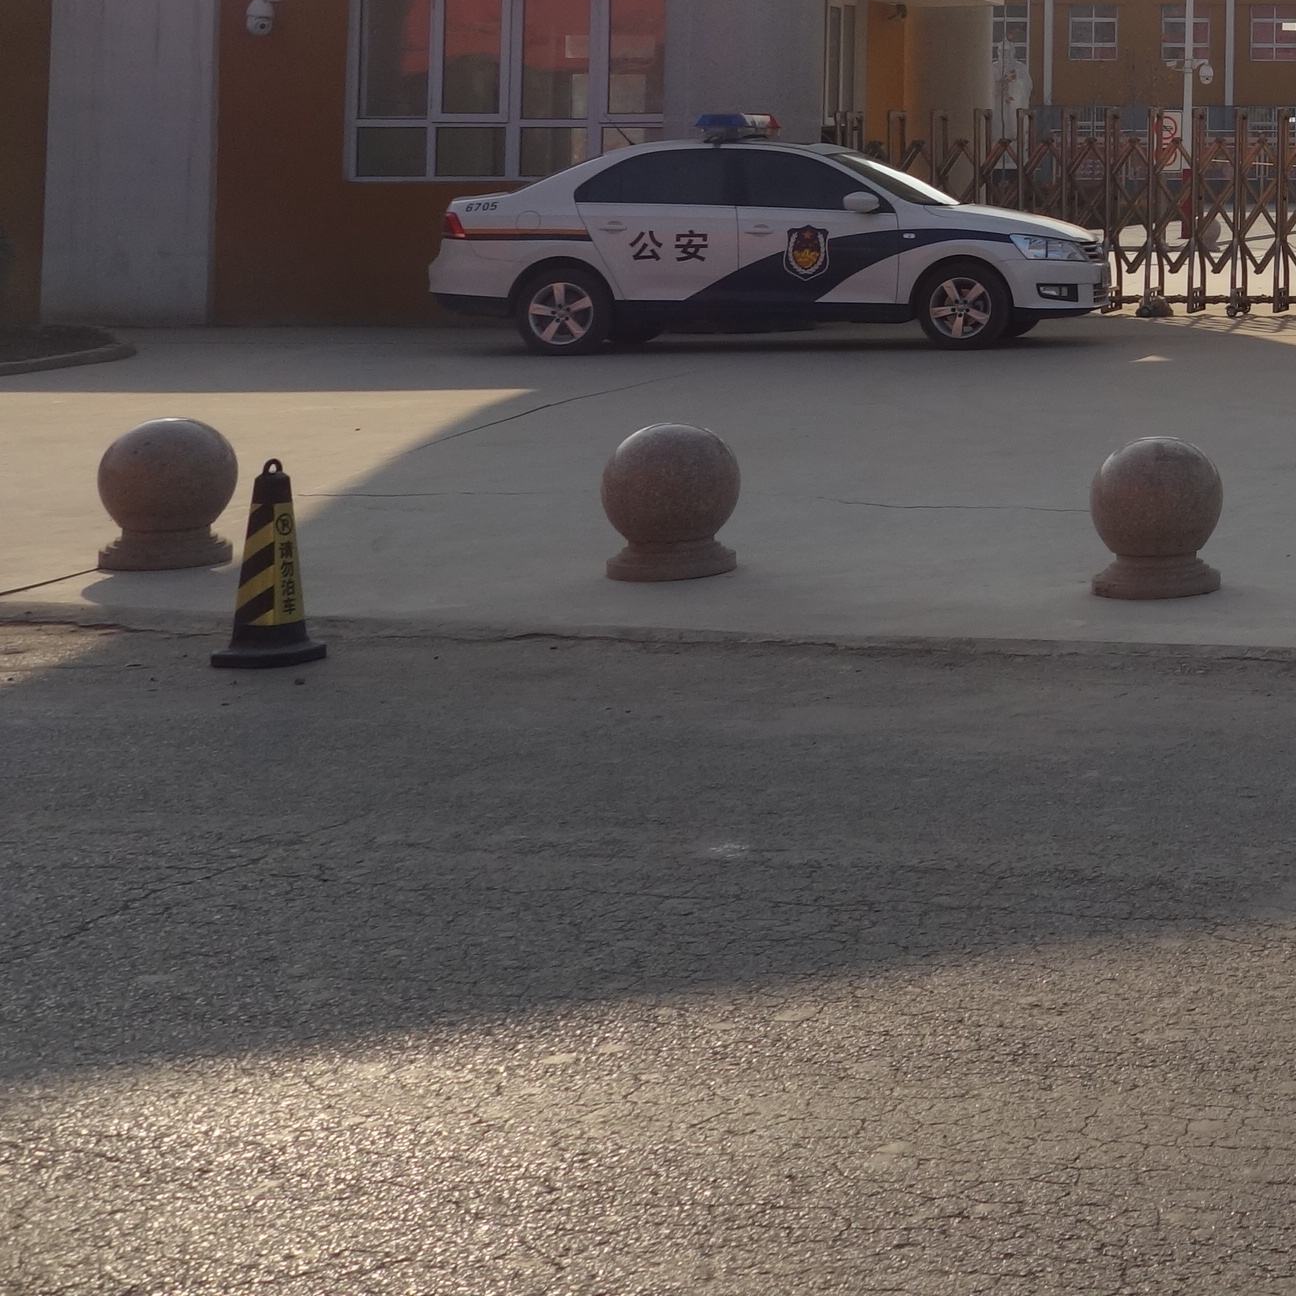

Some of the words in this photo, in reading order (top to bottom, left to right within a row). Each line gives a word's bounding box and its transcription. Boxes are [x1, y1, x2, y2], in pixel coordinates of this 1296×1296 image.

[465, 202, 498, 212] 6705
[629, 230, 708, 262] 公安
[279, 542, 296, 615] 请勿泊车
